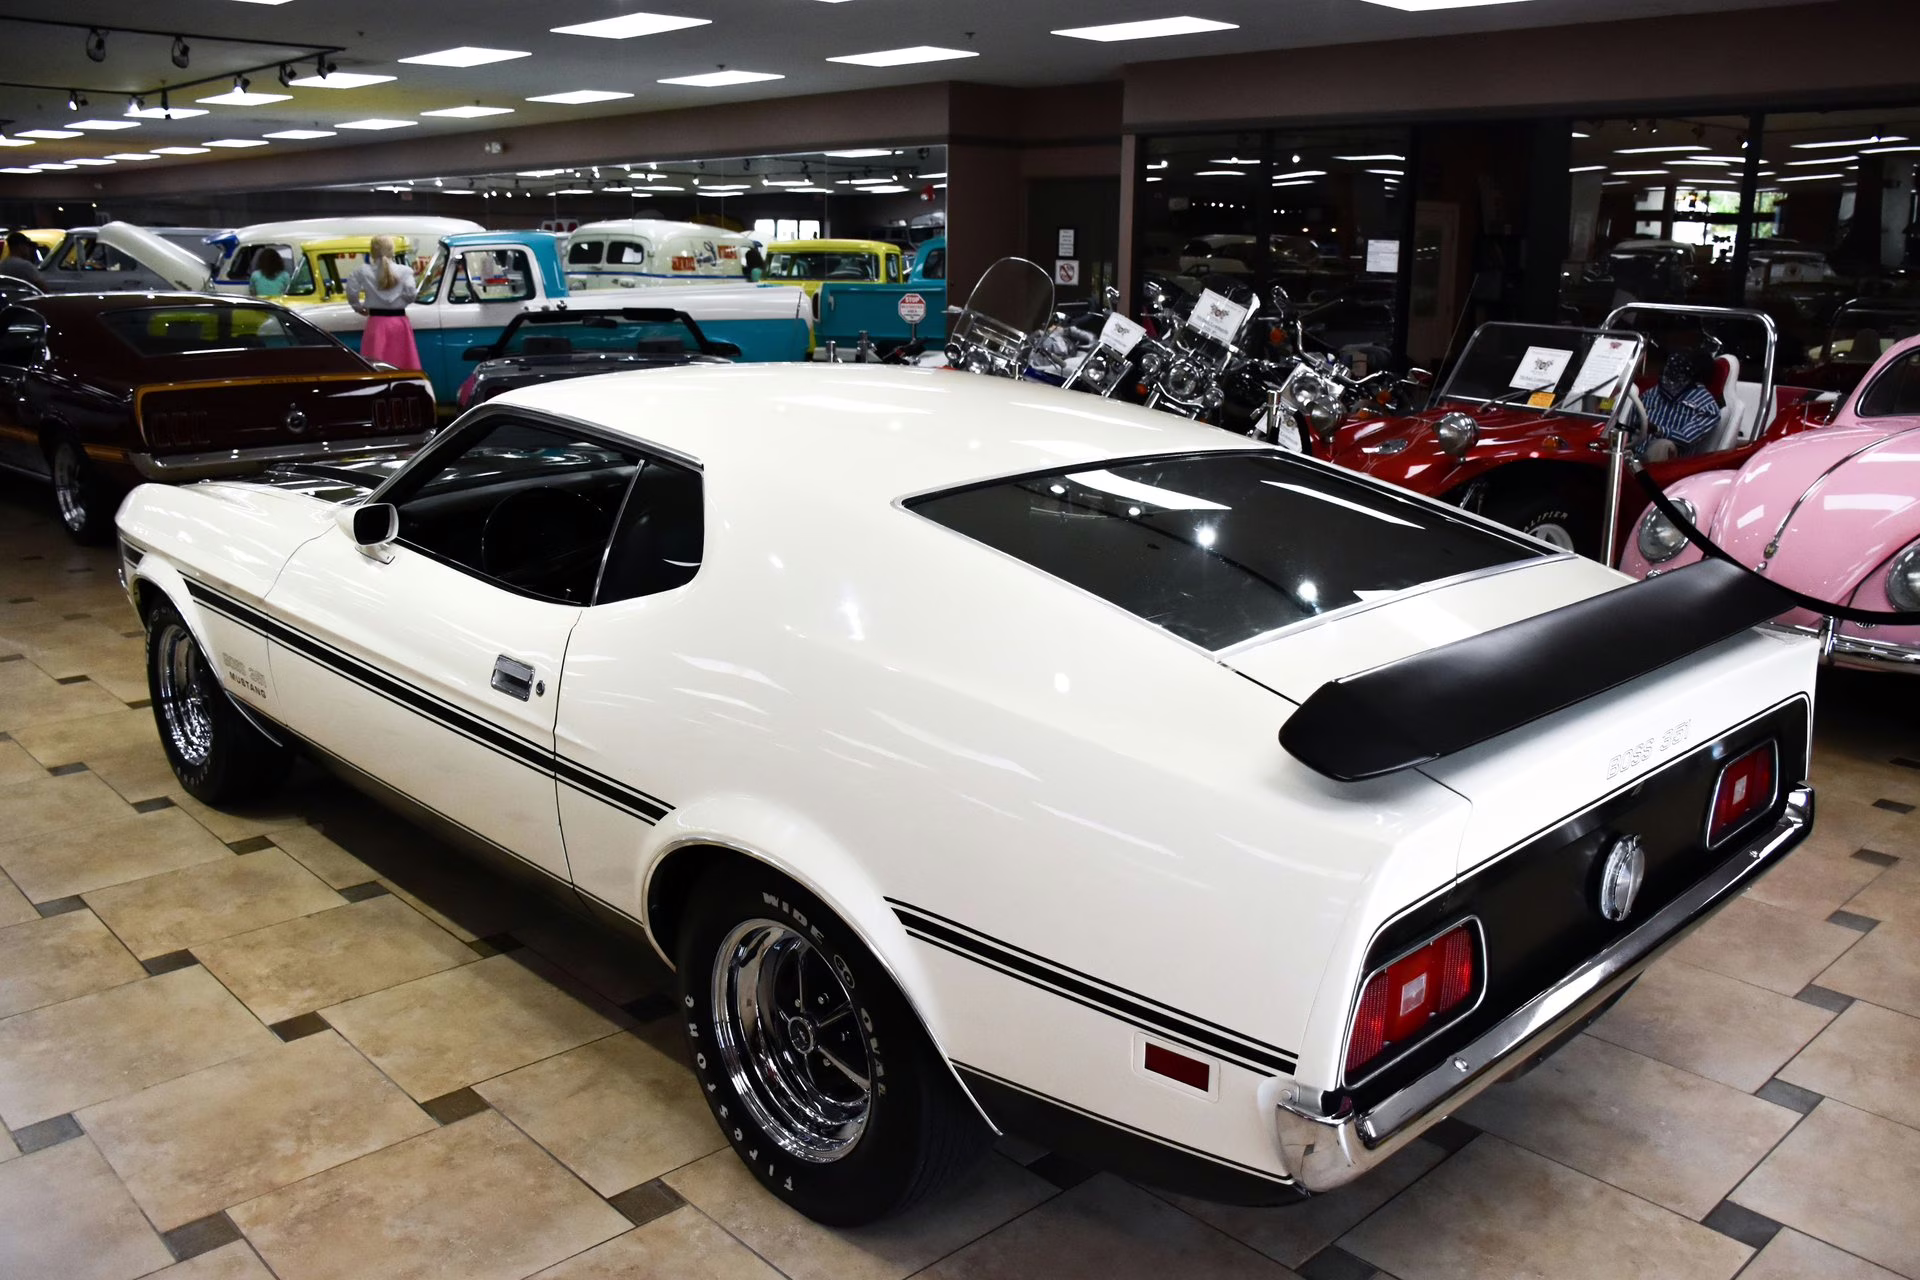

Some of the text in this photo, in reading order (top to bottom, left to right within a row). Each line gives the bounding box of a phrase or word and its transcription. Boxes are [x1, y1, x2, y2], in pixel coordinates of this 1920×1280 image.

[1523, 511, 1569, 534] ALIFIER
[229, 671, 267, 699] MUSTANG
[1606, 718, 1692, 781] BOSS 351
[762, 891, 825, 945] WIDE
[860, 1007, 887, 1097] OVAL
